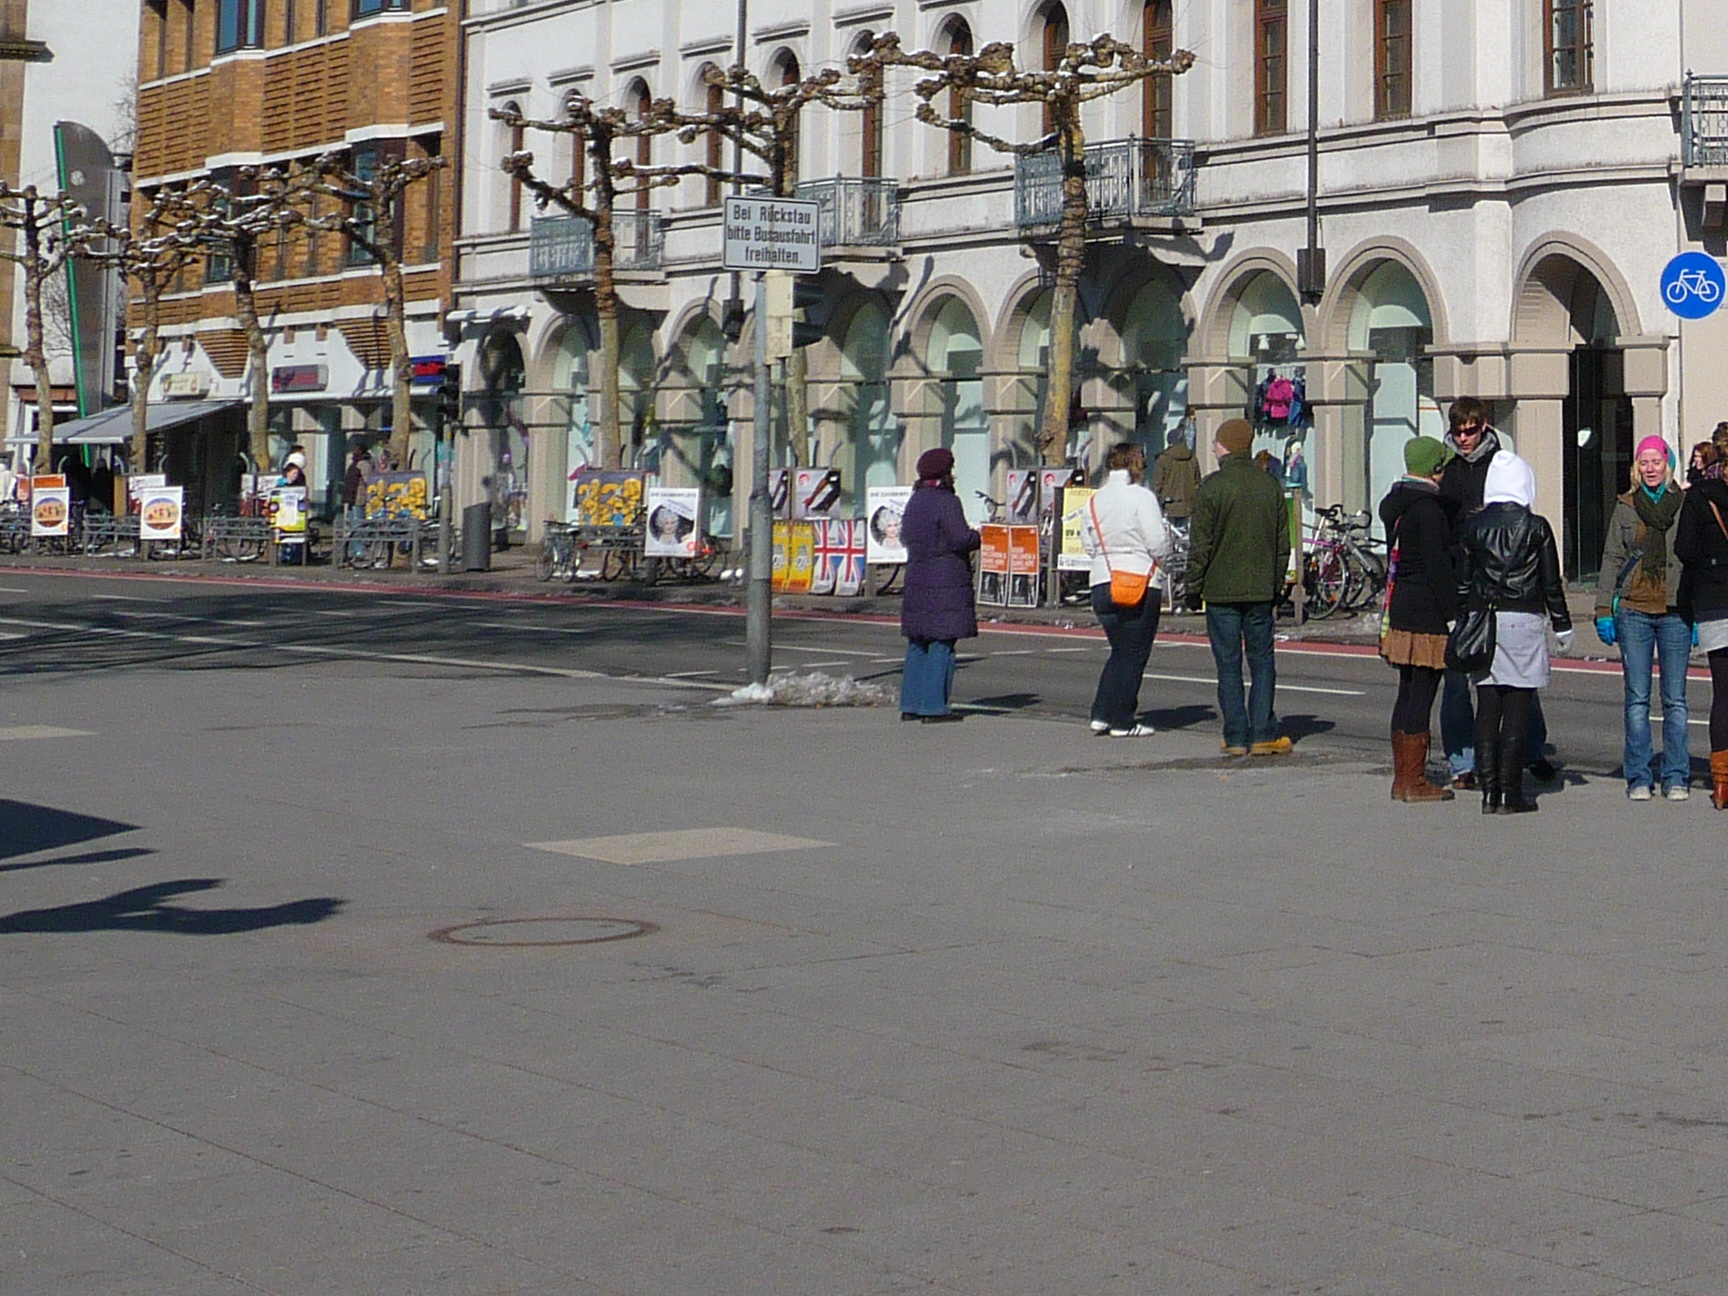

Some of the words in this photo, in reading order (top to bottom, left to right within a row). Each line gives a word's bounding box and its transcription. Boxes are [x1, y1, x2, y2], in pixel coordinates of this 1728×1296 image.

[733, 204, 751, 221] Bei
[760, 204, 811, 225] Rückstau
[727, 225, 751, 241] bitte
[754, 226, 816, 245] Busausfahrt
[745, 246, 803, 264] freihalten.
